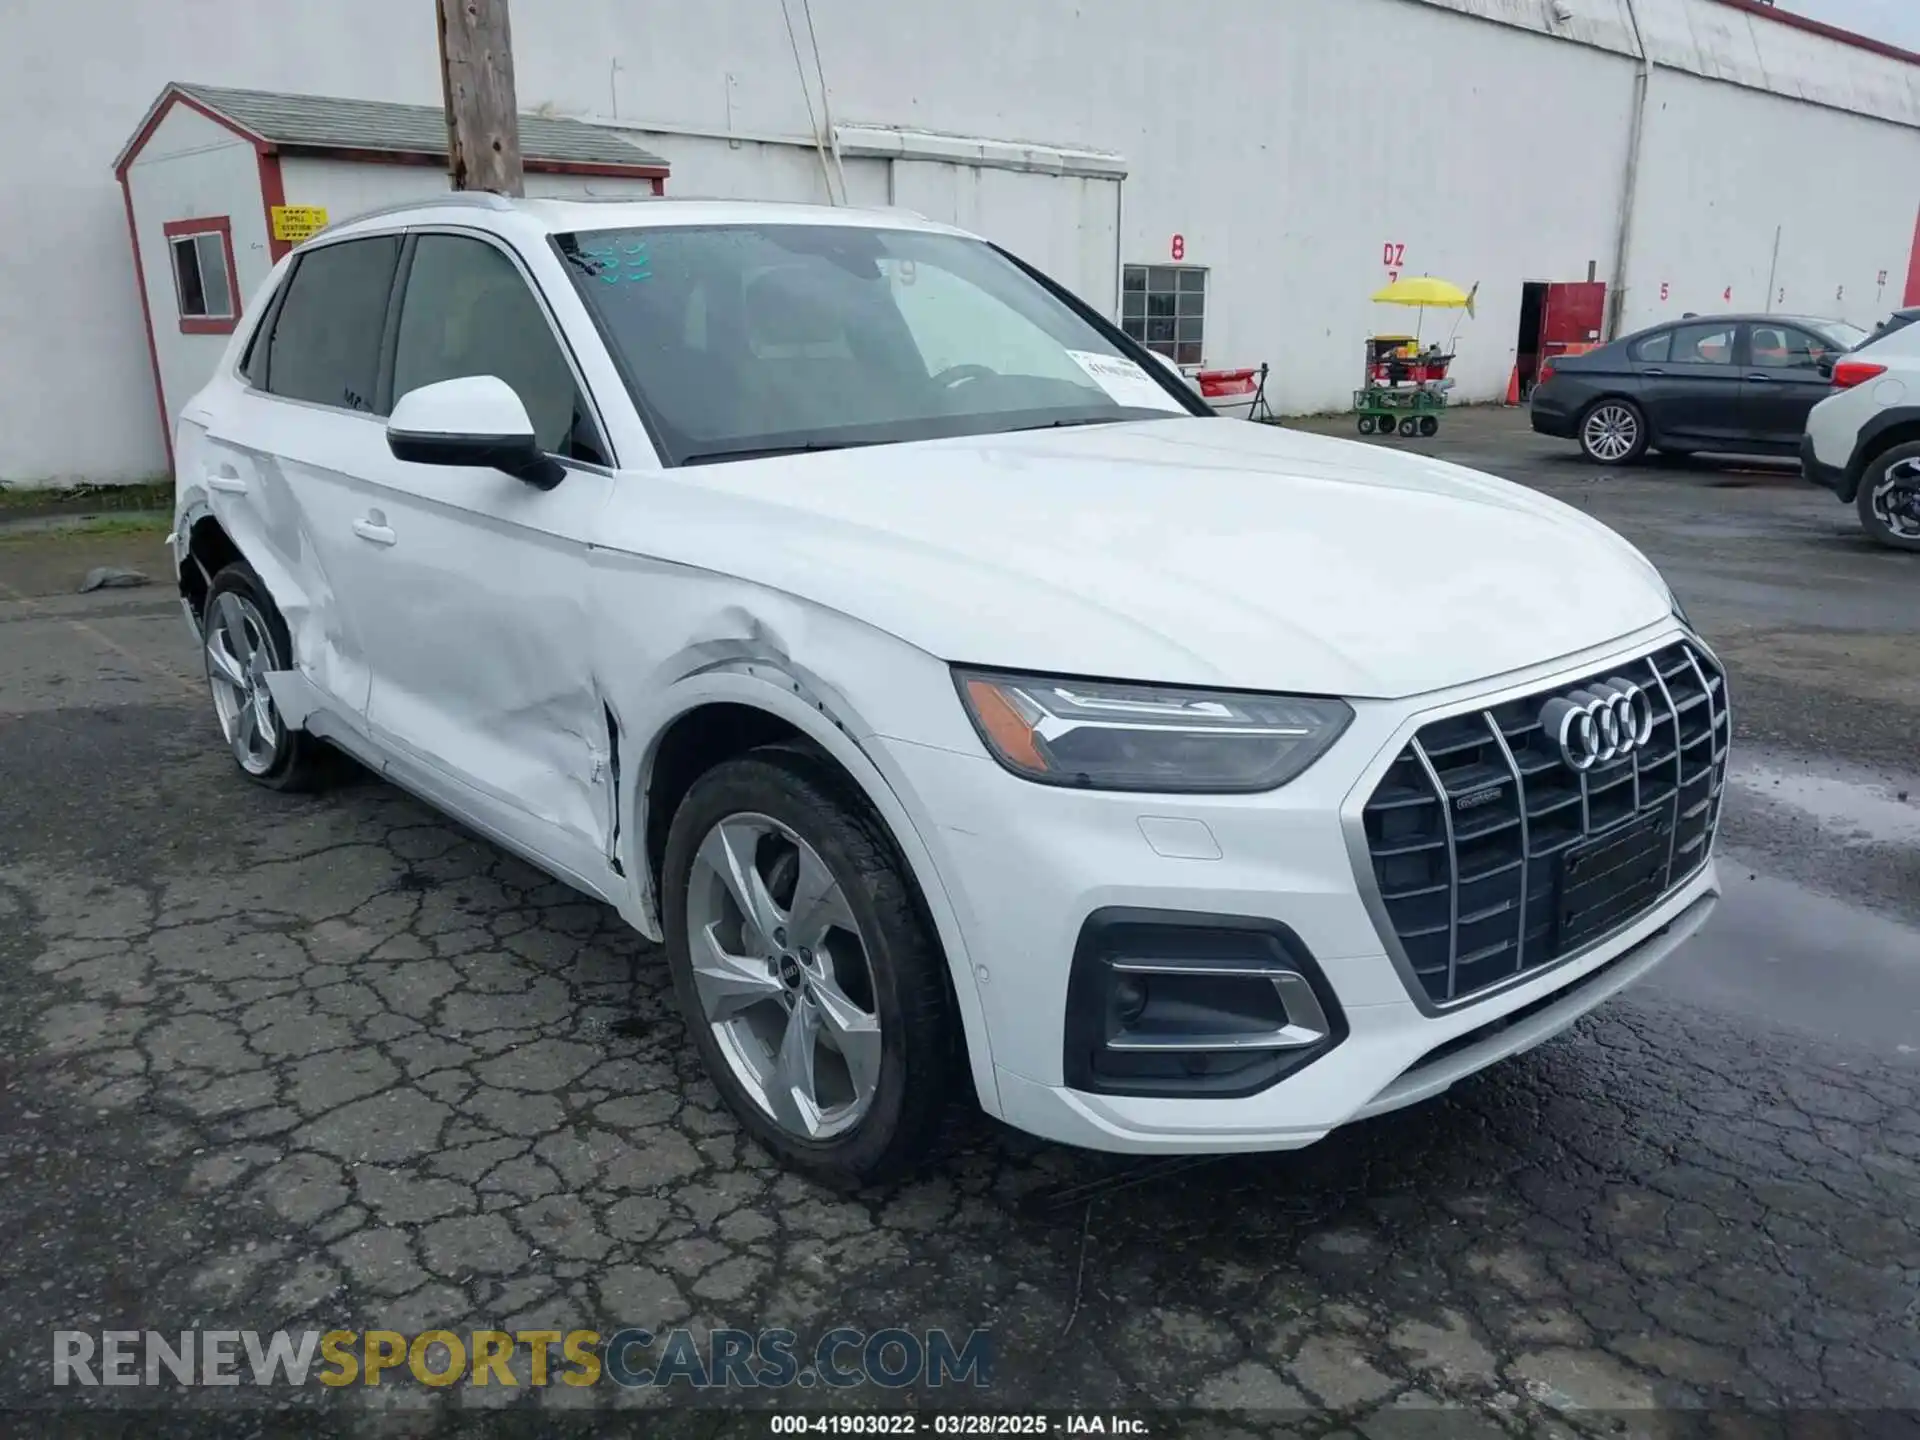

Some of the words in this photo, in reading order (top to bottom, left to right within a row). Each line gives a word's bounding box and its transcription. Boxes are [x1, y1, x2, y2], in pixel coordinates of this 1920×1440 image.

[1172, 234, 1185, 260] 8
[1383, 243, 1405, 266] DZ
[1660, 283, 1669, 300] 5
[1723, 286, 1731, 301] 4
